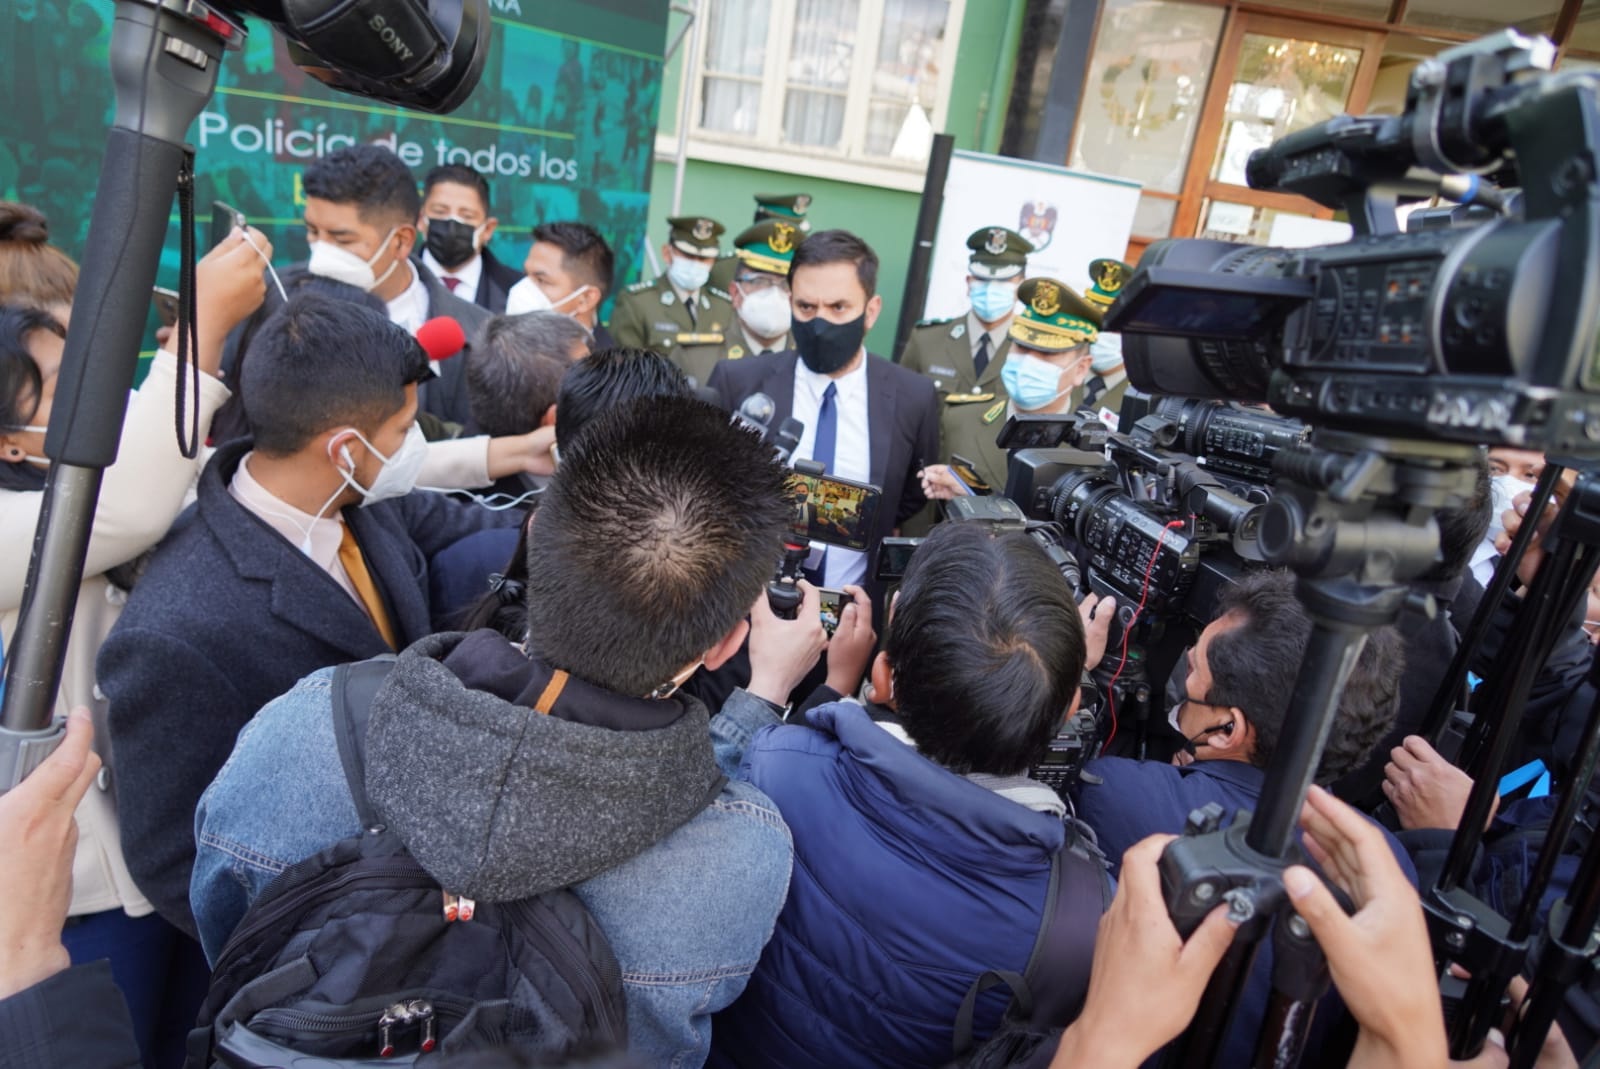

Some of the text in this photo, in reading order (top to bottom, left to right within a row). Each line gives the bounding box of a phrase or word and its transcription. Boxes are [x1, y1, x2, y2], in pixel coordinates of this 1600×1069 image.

[368, 14, 414, 61] SONY
[435, 138, 532, 177] todos
[539, 151, 578, 182] los
